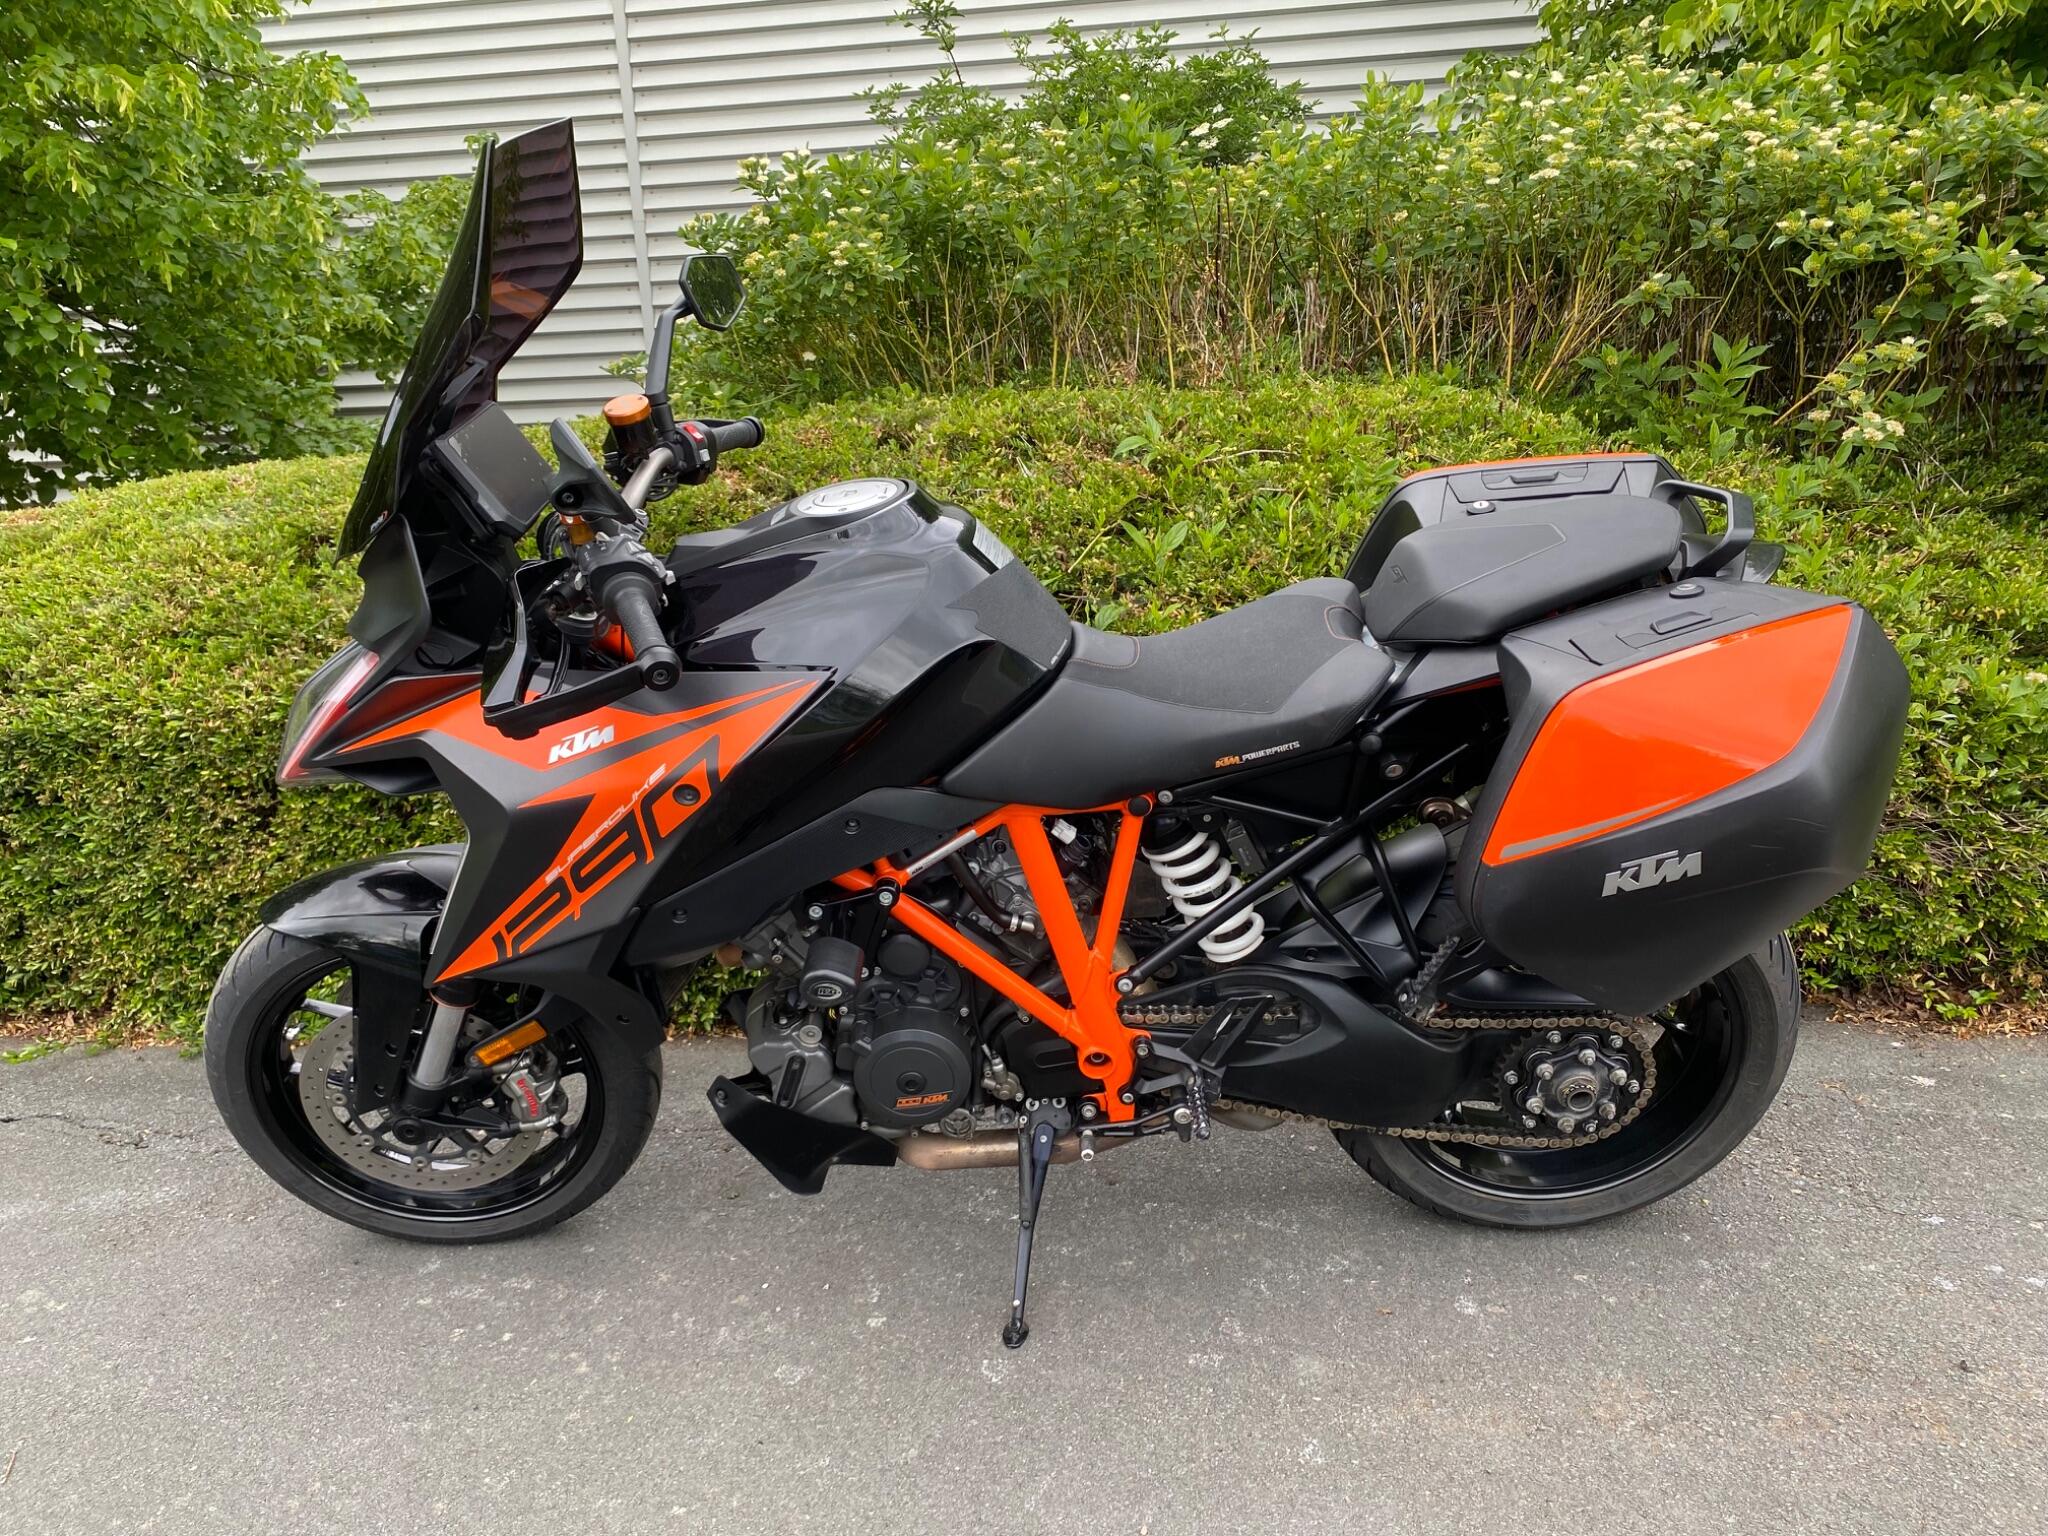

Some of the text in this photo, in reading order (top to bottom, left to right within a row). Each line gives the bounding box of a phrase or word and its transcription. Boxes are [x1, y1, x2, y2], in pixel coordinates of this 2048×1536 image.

[547, 725, 614, 764] KTM
[1215, 741, 1300, 768] KTM POWERPARTS
[491, 734, 722, 962] 1290
[1602, 850, 1702, 897] KTM
